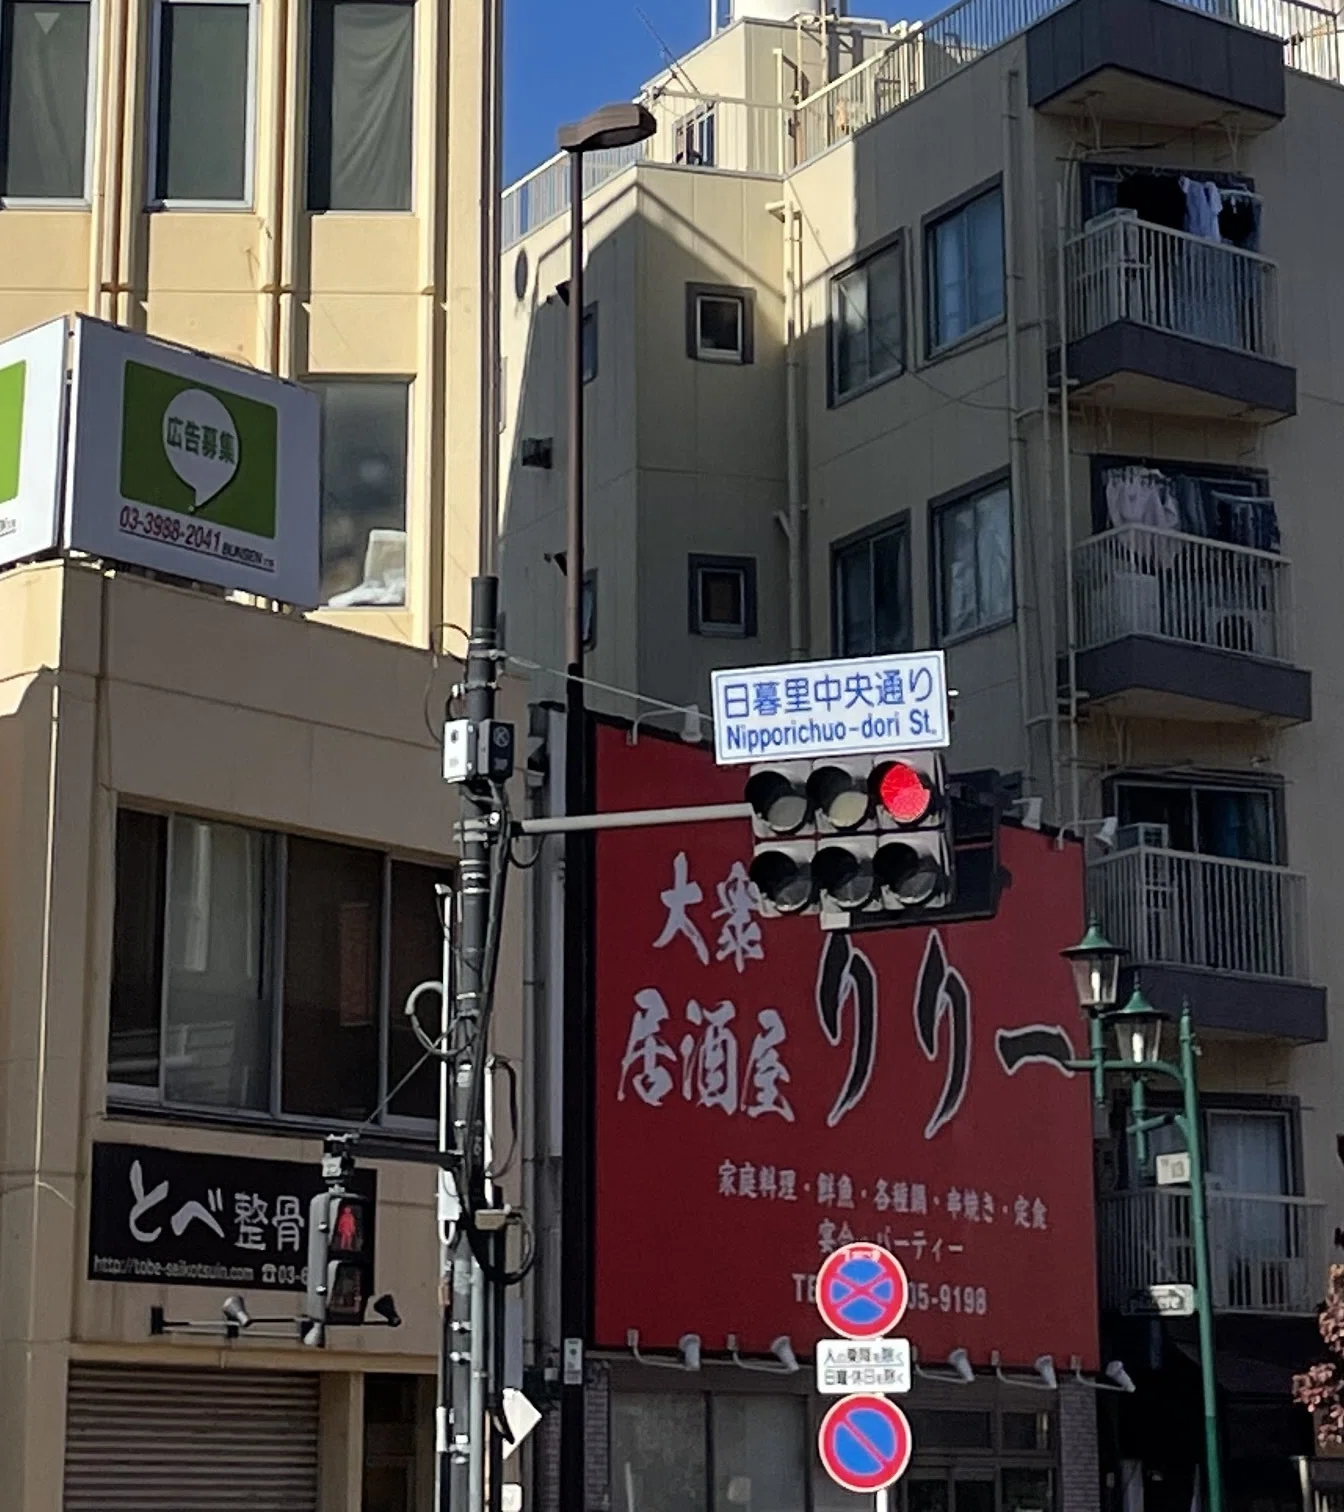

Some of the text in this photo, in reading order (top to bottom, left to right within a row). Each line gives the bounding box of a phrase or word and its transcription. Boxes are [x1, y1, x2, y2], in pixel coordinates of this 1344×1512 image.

[167, 416, 235, 465] 広告募集
[724, 667, 934, 719] 日暮里中央通り
[726, 708, 937, 753] Nipporichuo-dori St.
[618, 988, 795, 1122] 居酒屋
[128, 1159, 308, 1253] とべ整骨
